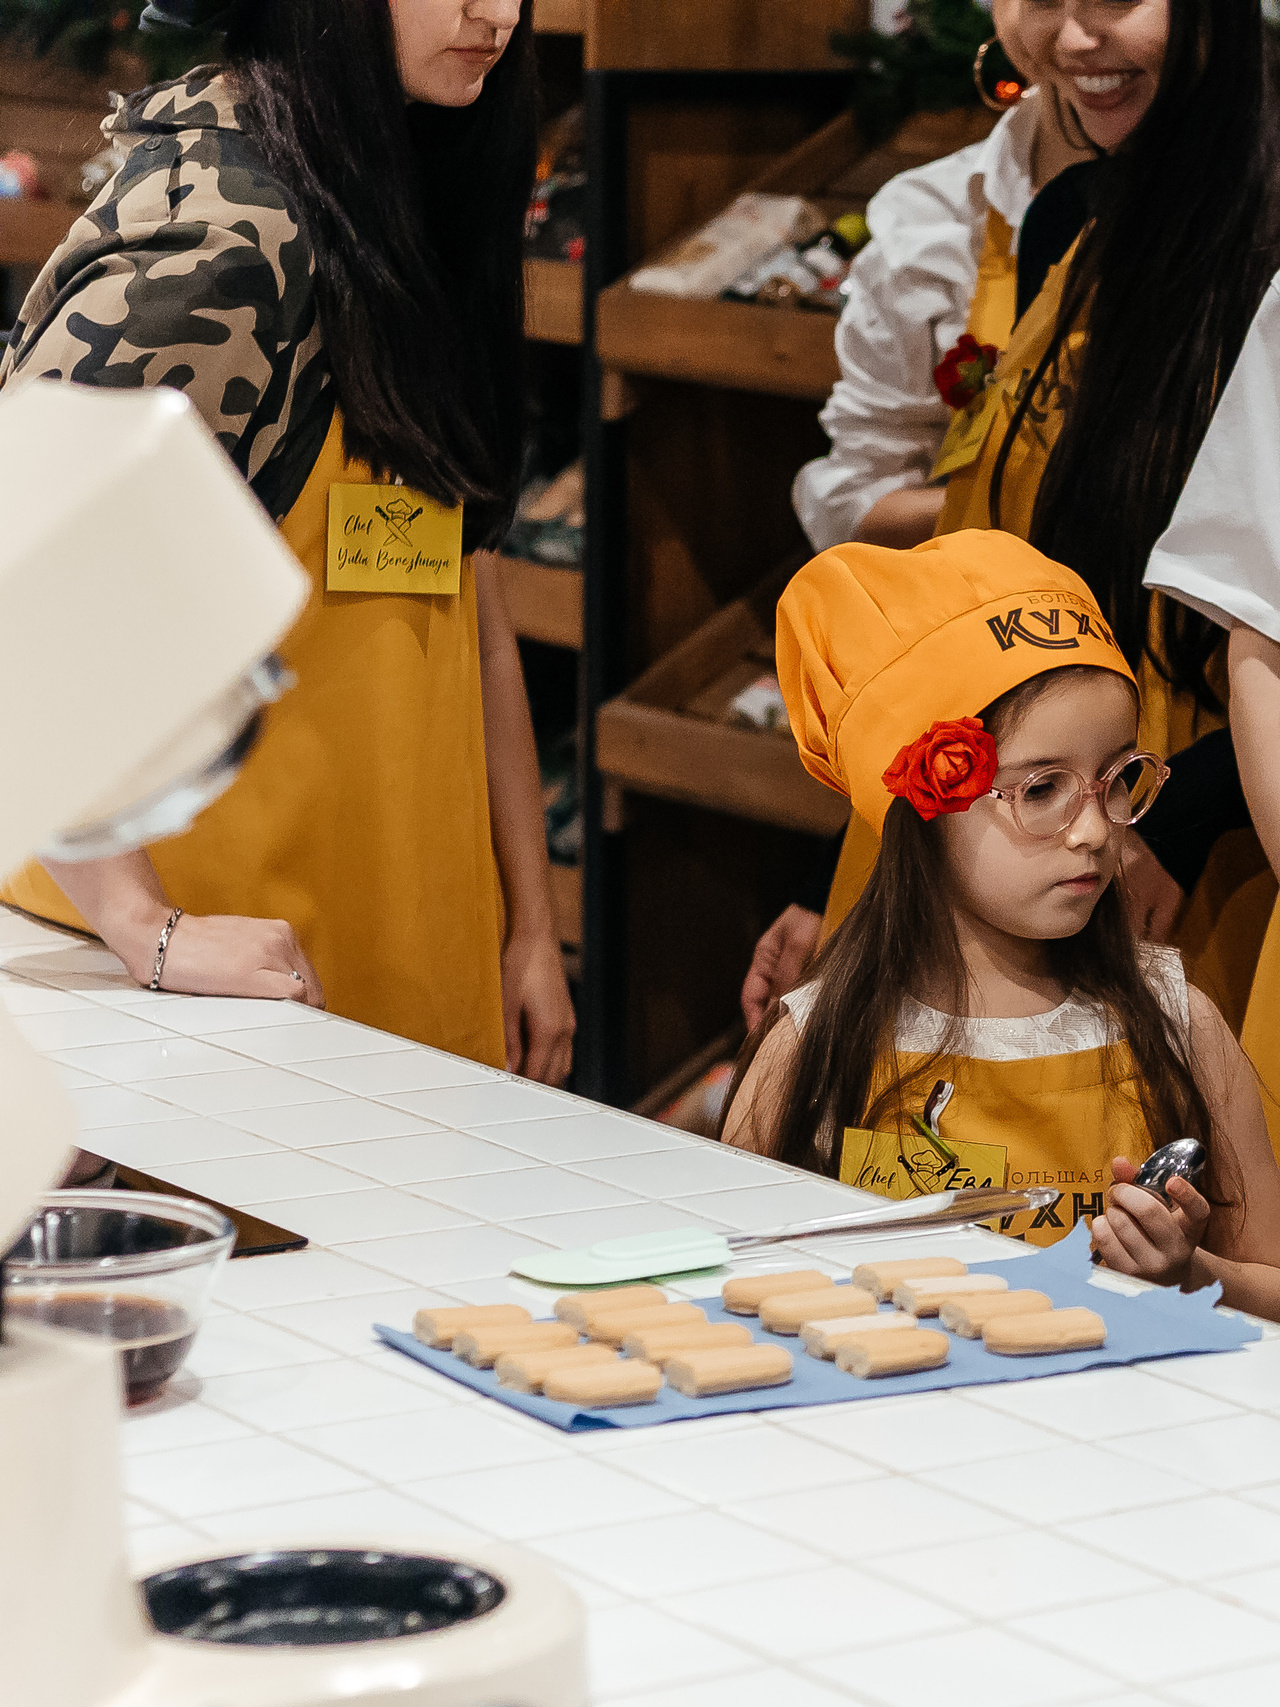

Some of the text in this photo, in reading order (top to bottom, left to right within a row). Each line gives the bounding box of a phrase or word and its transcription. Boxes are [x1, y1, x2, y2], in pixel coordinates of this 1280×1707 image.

[344, 514, 373, 536] Chef
[338, 547, 369, 571] Yulia
[860, 1165, 896, 1190] Chef
[1011, 1169, 1103, 1185] ОЛЬШАЯ
